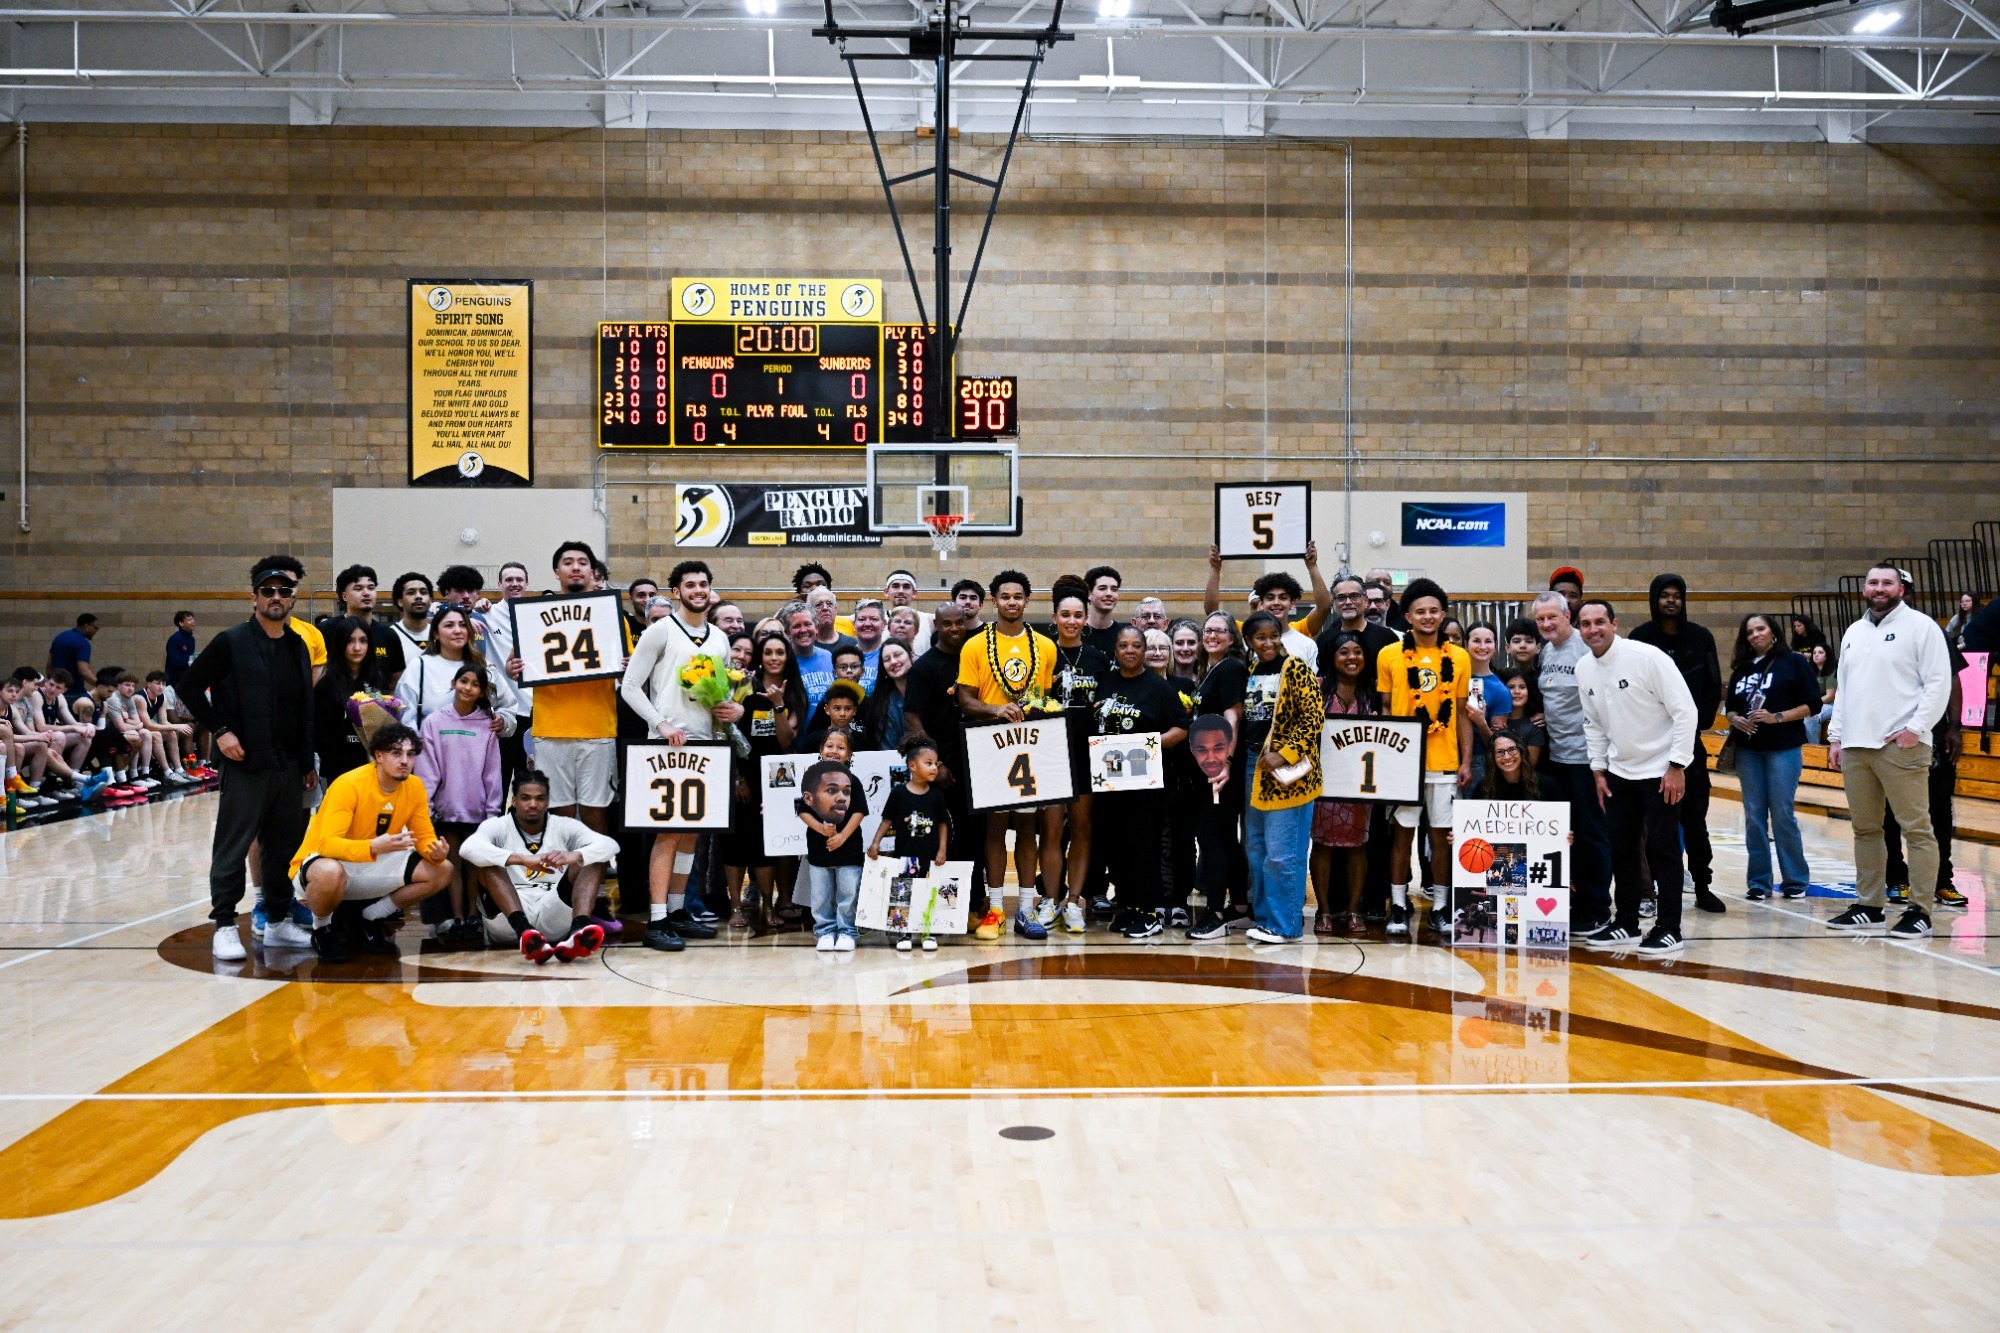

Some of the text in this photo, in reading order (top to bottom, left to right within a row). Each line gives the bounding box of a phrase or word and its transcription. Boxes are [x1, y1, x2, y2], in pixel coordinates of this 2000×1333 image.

[730, 284, 826, 296] HOME OF THE
[455, 297, 512, 307] PENGUINS
[730, 300, 826, 317] PENGUINS
[435, 314, 504, 325] SPIRIT SONG
[602, 325, 668, 338] PLY FL PTS
[740, 326, 814, 352] 20:00
[885, 327, 906, 340] PLY
[911, 327, 925, 340] FL
[418, 339, 434, 347] OUR
[436, 339, 464, 347] SCHOOL
[466, 339, 476, 347] TO
[478, 339, 488, 347] US
[490, 339, 500, 347] SO
[619, 340, 666, 355] 1 0 0
[897, 342, 922, 357] 2 0
[425, 349, 446, 358] WE'LL
[448, 349, 474, 358] HONOR
[494, 349, 516, 358] WE'LL
[446, 359, 495, 367] CHERISH YOU
[616, 358, 666, 373] 3 0 0
[682, 356, 734, 370] PENGUINS
[763, 364, 792, 374] PERIOD
[819, 357, 871, 370] SUNBIRDS
[898, 359, 922, 374] 3 0
[615, 375, 666, 390] 5 0 0
[712, 373, 726, 398] 0
[778, 377, 784, 395] 1
[851, 373, 866, 399] 0
[898, 376, 922, 391] 7 0
[961, 380, 1013, 399] 20:00
[434, 390, 508, 398] YOUR FLAG UNFOLDS
[604, 392, 666, 407] 23 0 0
[897, 394, 922, 409] 8 0
[433, 400, 509, 408] THE WHITE AND GOLD
[686, 404, 706, 418] FLS
[747, 404, 808, 418] PLYR FOUL
[846, 405, 867, 418] FLS
[421, 410, 453, 418] BELOVED
[480, 410, 509, 418] ALWAYS
[510, 410, 520, 418] BE
[604, 410, 666, 425] 24 0 0
[720, 408, 741, 417] T.O.L.
[815, 408, 834, 417] T.O.L.
[888, 411, 922, 427] 34 0
[964, 399, 1005, 430] 30
[428, 420, 513, 428] AND FROM OUR HEARTS
[693, 422, 706, 442] 0
[723, 423, 736, 441] 4
[818, 423, 830, 441] 4
[854, 422, 866, 442] 0
[432, 440, 445, 448] ALL
[466, 440, 478, 448] ALL
[480, 440, 497, 448] HAIL
[767, 488, 866, 510] PENGUIN
[1246, 491, 1282, 507] BEST
[781, 506, 854, 528] RADIO
[1416, 518, 1490, 531] NCAA.com
[1252, 513, 1274, 550] 5
[540, 604, 591, 627] OCHOA
[542, 628, 601, 674] 24
[801, 672, 834, 688] MINICA
[1735, 672, 1773, 695] SSU
[1112, 706, 1141, 717] DAVIS
[993, 728, 1039, 750] DAVIS
[1331, 725, 1410, 753] MEDEIROS
[646, 752, 710, 774] TAGORE
[1007, 752, 1037, 797] 4
[1360, 750, 1377, 794] 1
[650, 778, 706, 822] 30
[1487, 802, 1534, 819] NICK
[1463, 820, 1559, 836] MEDEIROS
[1529, 851, 1569, 888] #1
